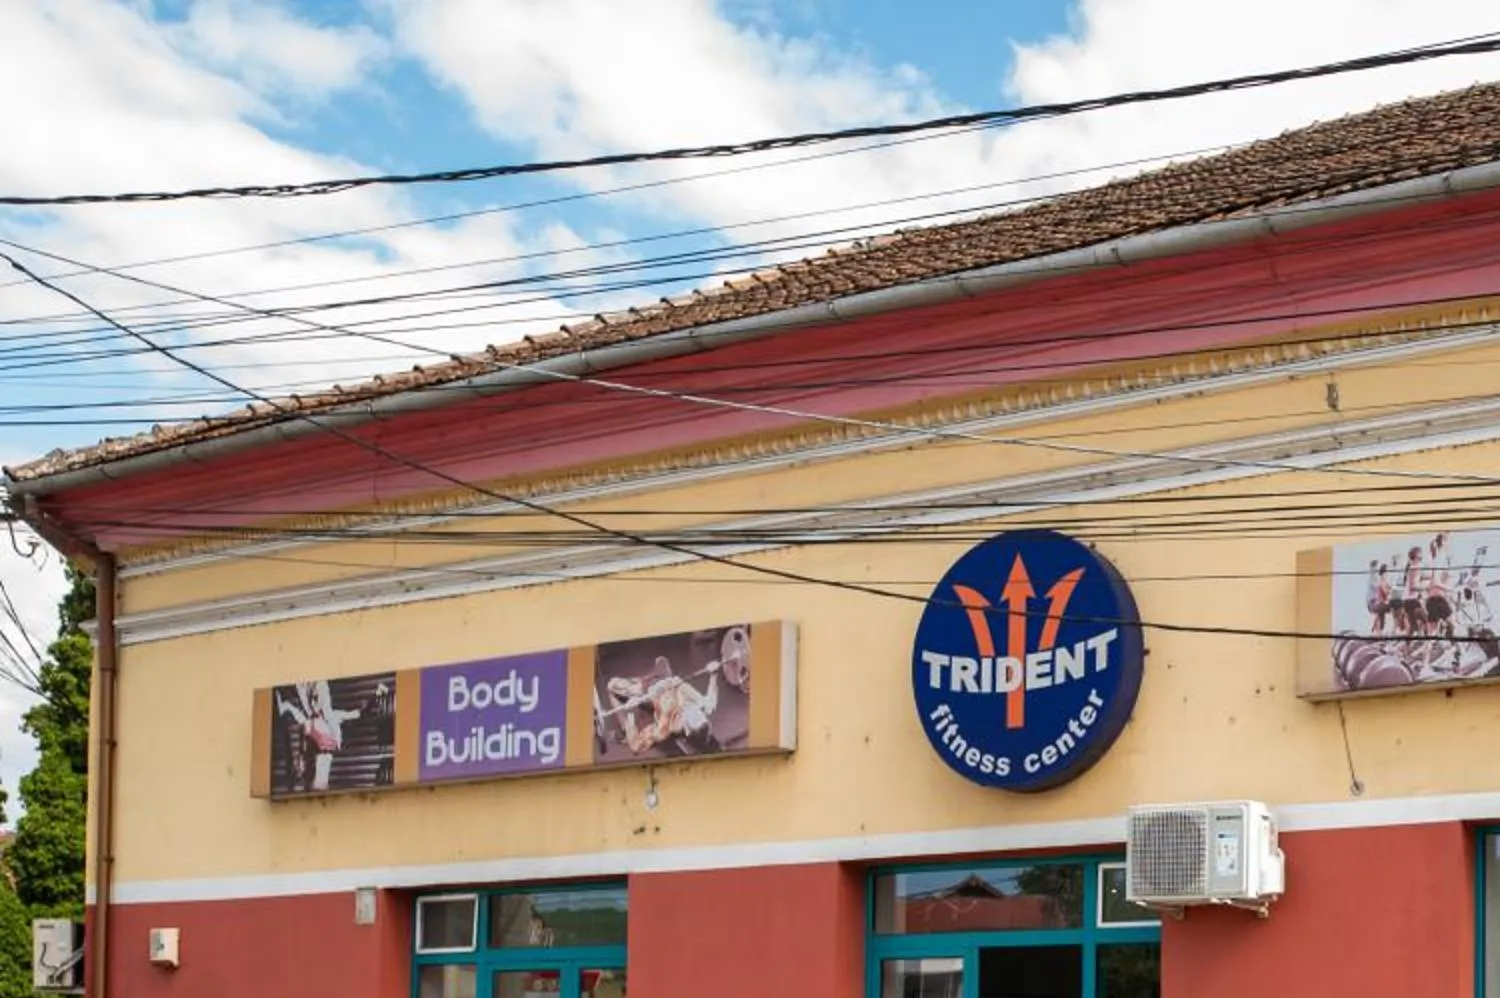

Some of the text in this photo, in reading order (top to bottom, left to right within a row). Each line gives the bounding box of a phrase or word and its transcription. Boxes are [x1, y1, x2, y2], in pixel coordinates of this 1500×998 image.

[921, 627, 1118, 694] TRIDENT
[447, 669, 540, 713] Body
[425, 722, 561, 767] Building
[929, 688, 1104, 776] fitness center
